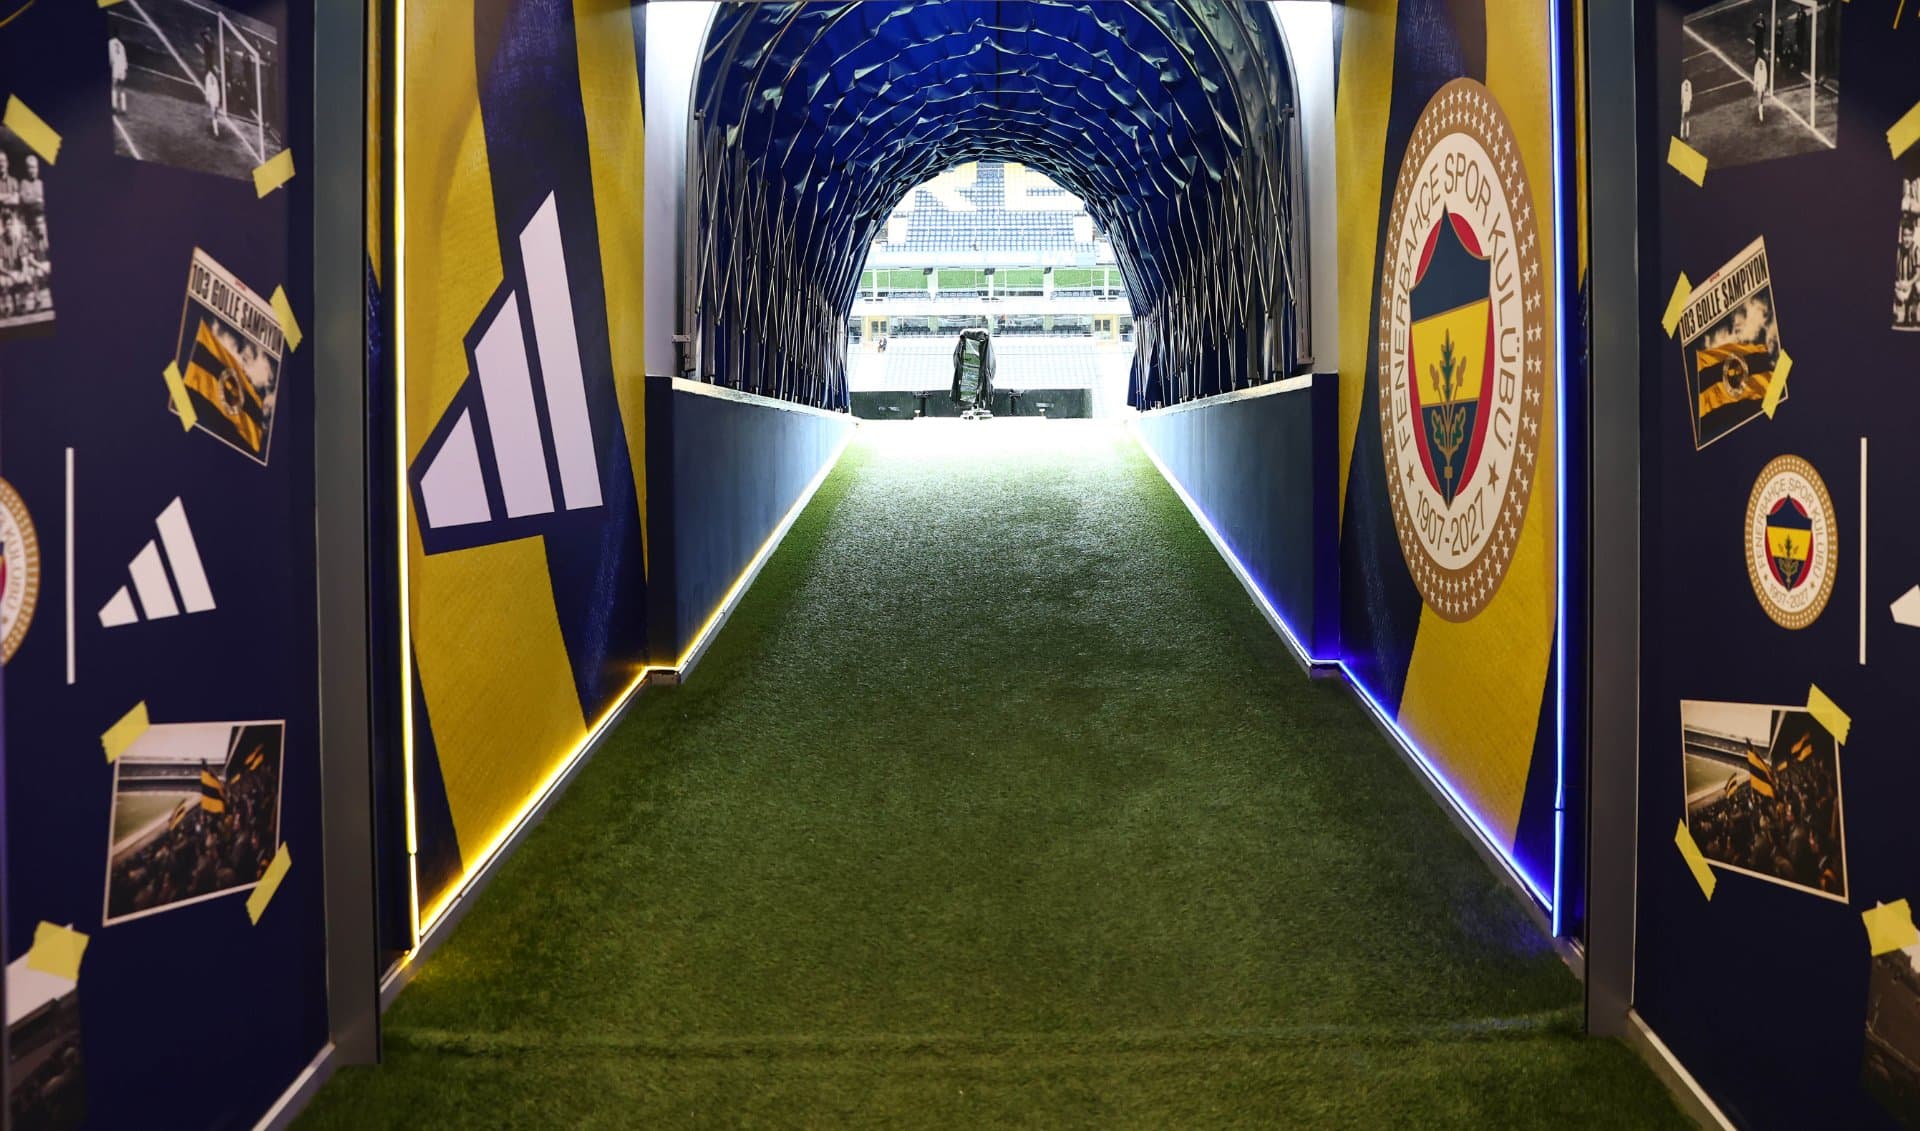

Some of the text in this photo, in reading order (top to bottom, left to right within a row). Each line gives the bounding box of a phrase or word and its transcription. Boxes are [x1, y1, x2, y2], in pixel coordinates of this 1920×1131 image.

[191, 264, 210, 300] 103
[211, 278, 241, 323] GOLLE
[1394, 152, 1520, 452] FENERBAHÇE SPOR KULÜBÜ
[1680, 308, 1696, 341] 103
[1695, 287, 1722, 328] GOLLE
[1789, 477, 1814, 505] SPOR
[1416, 487, 1485, 556] 1907-2027
[1769, 583, 1809, 608] 1907-2027
